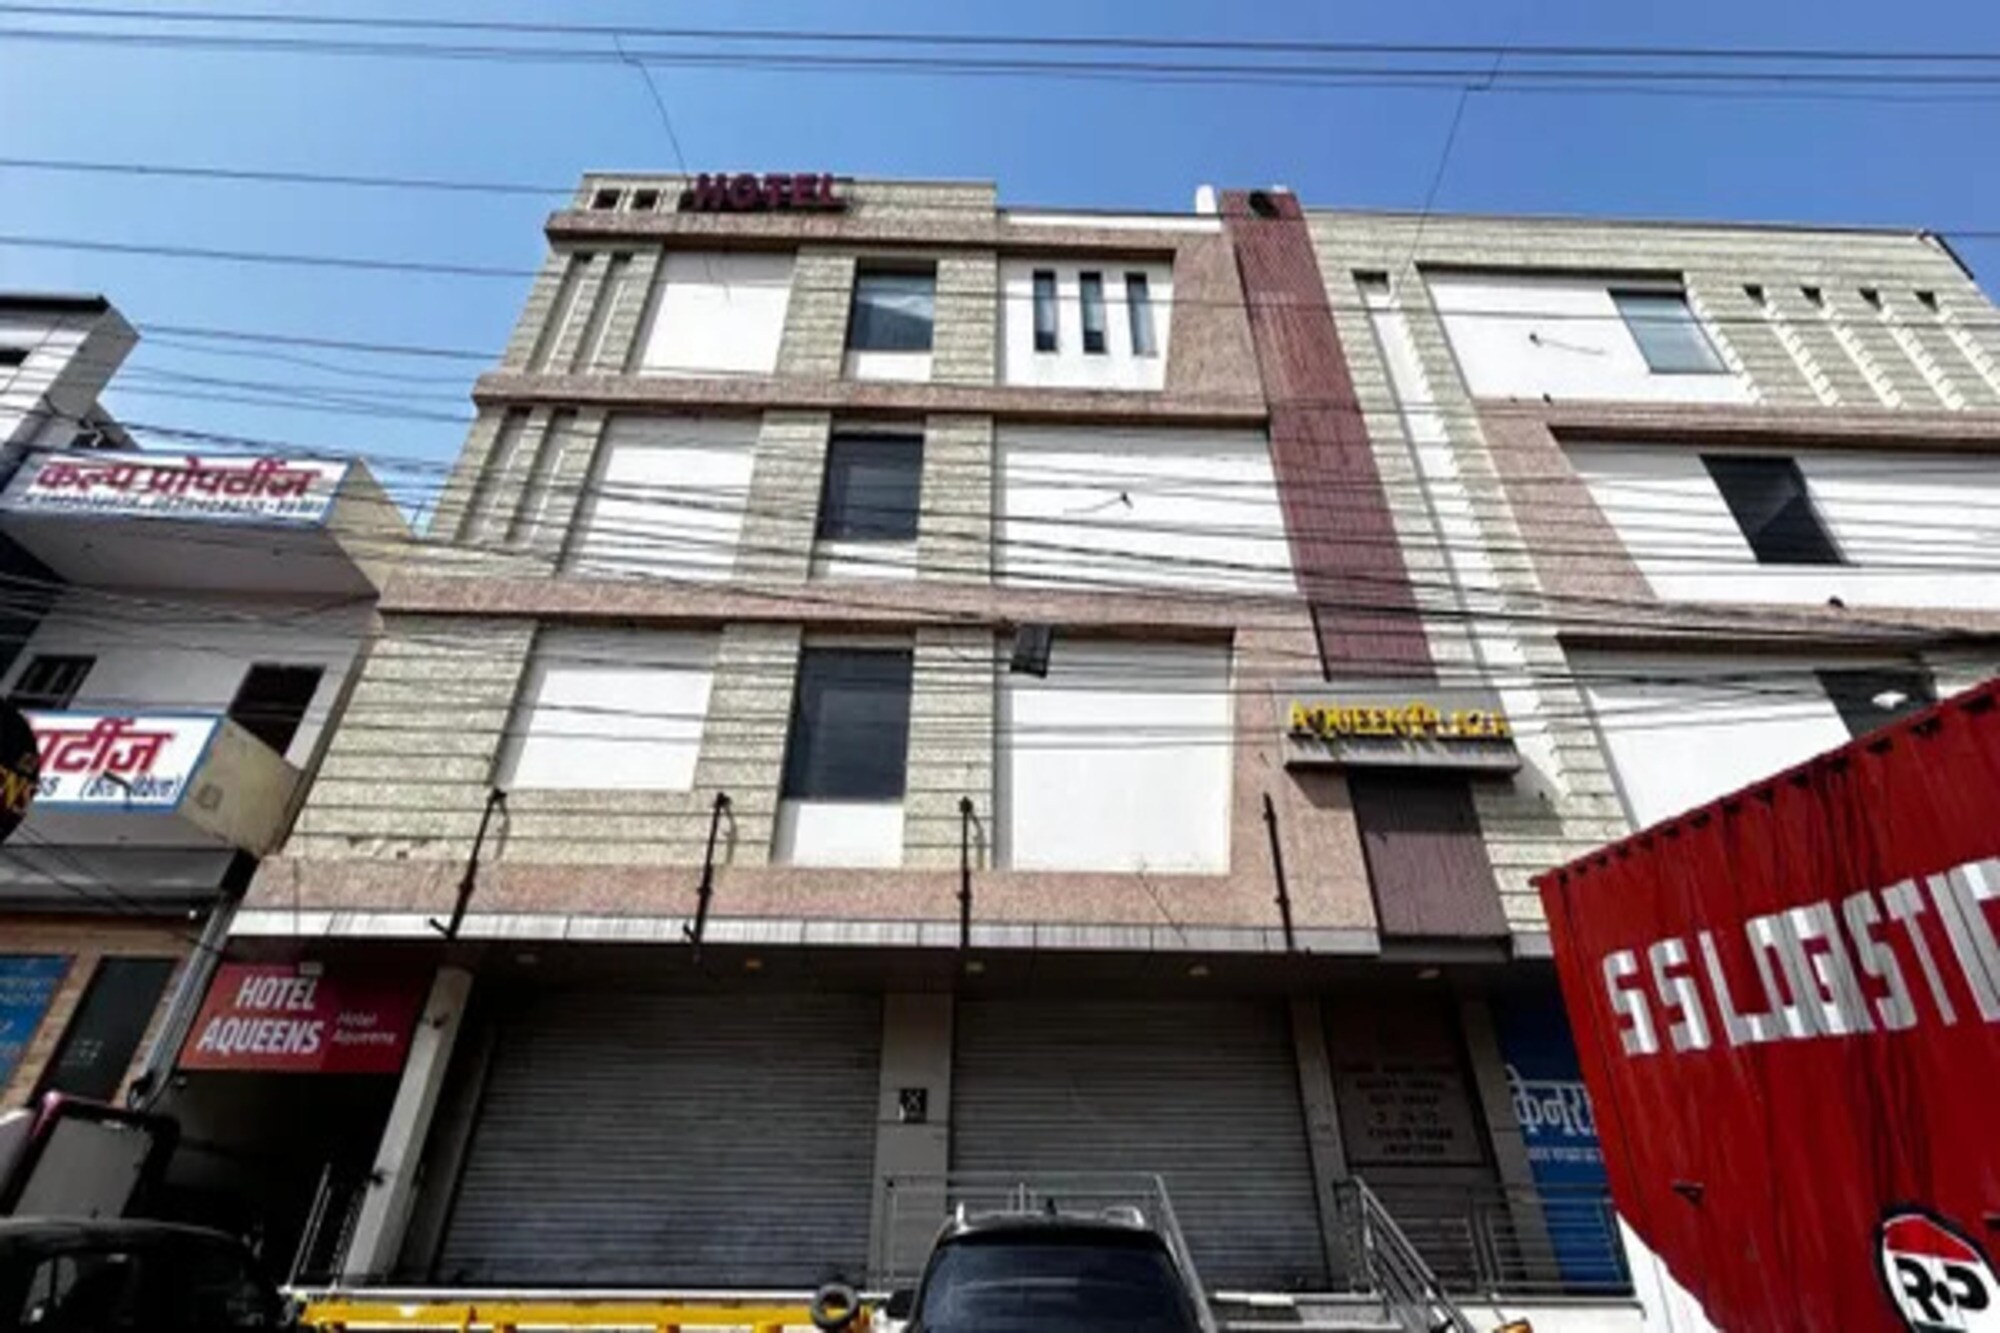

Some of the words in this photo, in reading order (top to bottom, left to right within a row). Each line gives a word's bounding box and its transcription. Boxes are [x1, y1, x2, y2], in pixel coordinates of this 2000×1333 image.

[695, 172, 845, 210] HOTEL
[235, 974, 318, 1010] HOTEL
[196, 1016, 325, 1056] AQUEENS
